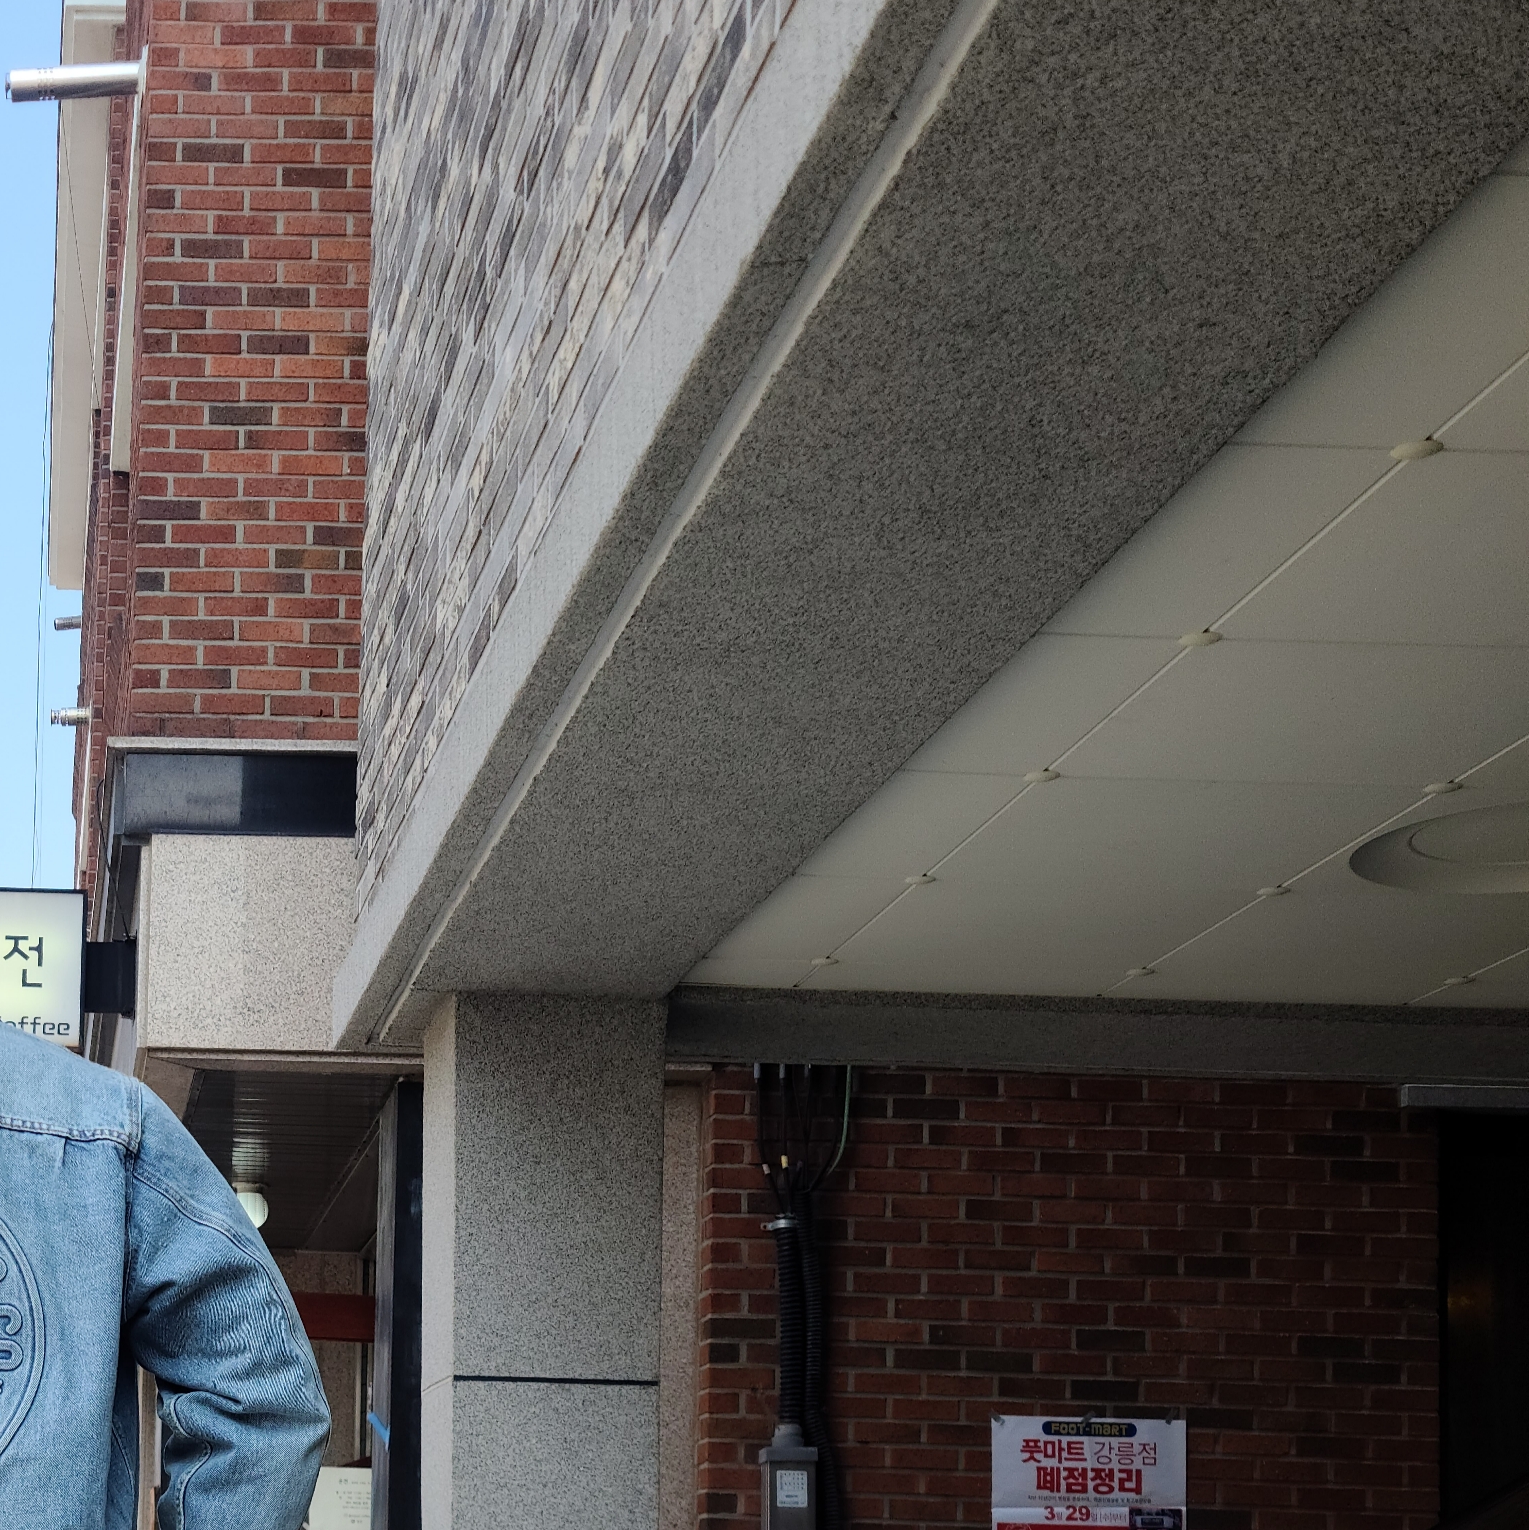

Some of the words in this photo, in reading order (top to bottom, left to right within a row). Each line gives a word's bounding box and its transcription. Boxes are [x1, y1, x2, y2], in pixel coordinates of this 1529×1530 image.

[1020, 1438, 1087, 1464] 풋마트
[1093, 1441, 1157, 1467] 강릉점
[1036, 1466, 1143, 1495] 폐점정리
